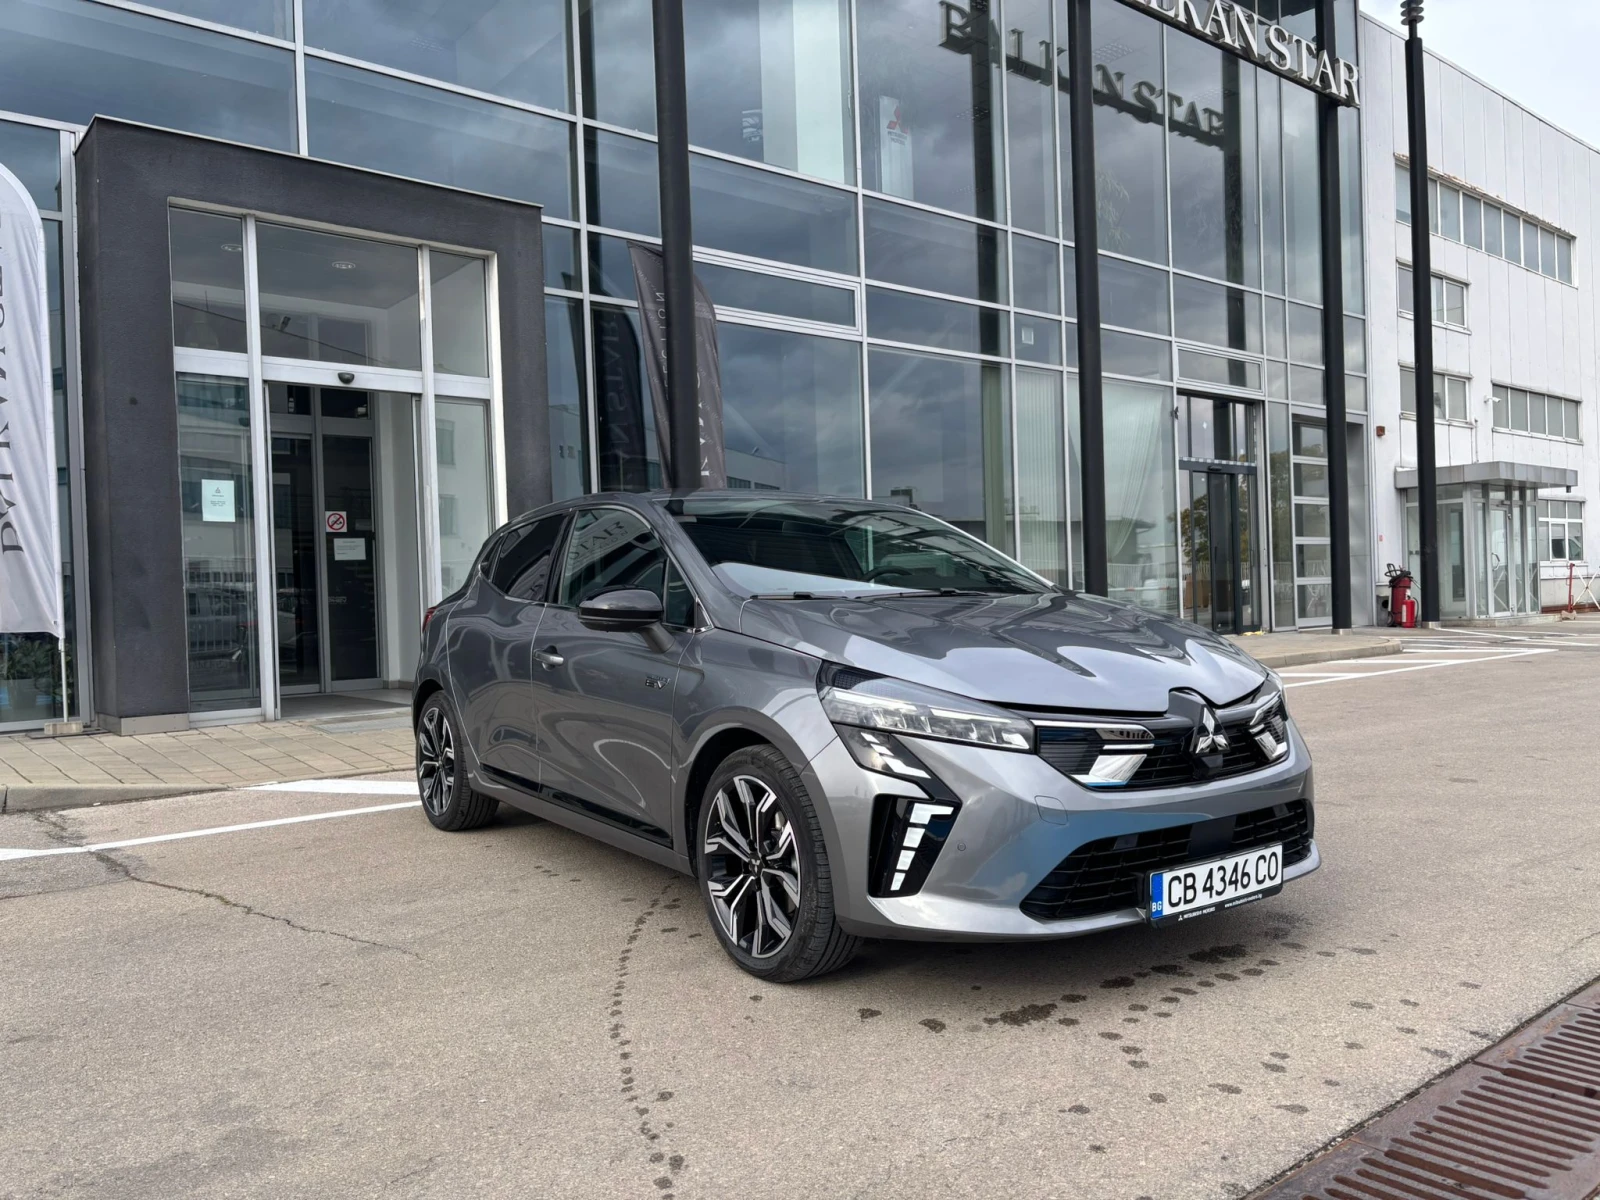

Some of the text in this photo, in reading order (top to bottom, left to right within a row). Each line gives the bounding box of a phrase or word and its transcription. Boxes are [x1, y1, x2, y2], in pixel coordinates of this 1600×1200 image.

[1264, 24, 1361, 109] STAR
[1152, 901, 1162, 912] BG
[1168, 851, 1279, 908] CB 4346 CO
